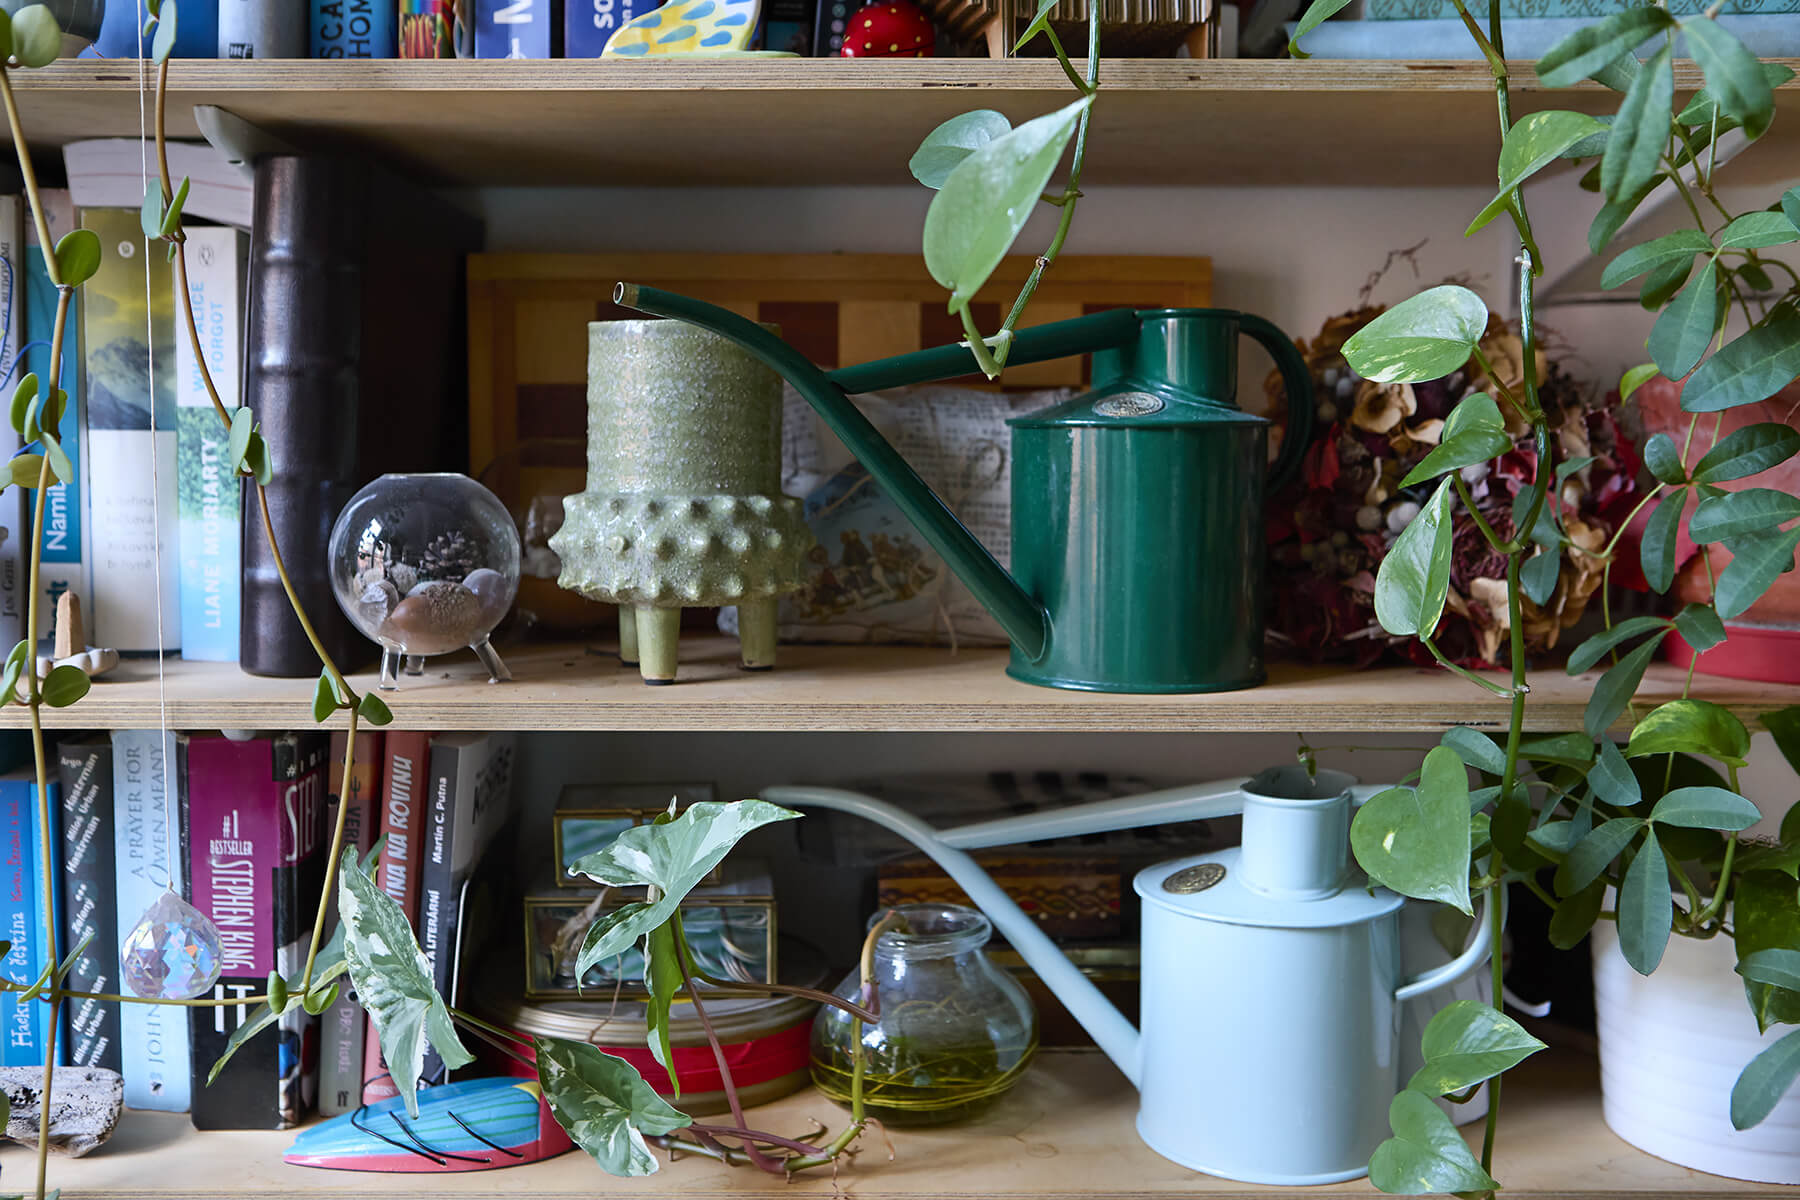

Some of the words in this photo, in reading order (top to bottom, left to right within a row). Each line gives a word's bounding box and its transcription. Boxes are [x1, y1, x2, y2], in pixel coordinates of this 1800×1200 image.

[191, 281, 205, 335] ALICE
[209, 301, 225, 374] FORGOT
[201, 437, 221, 555] MORIARTY
[205, 564, 221, 628] LIANE
[64, 752, 99, 812] Hastrman
[126, 745, 142, 784] FOR
[151, 743, 166, 813] MEANY
[388, 754, 413, 829] ROVINU
[78, 784, 100, 815] Urban
[433, 811, 446, 825] C.
[435, 776, 448, 810] Putna
[65, 815, 101, 874] Hastrman
[127, 791, 145, 860] PRAYER
[209, 840, 253, 857] BESTSELLER
[222, 809, 239, 839] #1
[387, 831, 408, 861] NA
[431, 828, 445, 865] Martin
[131, 868, 145, 880] A
[211, 859, 255, 930] STEPHEN
[8, 911, 28, 966] čeština
[425, 889, 441, 949] LITERÁRNÍ
[217, 931, 256, 970] KING
[85, 1008, 107, 1038] Urban
[146, 1004, 166, 1065] JOHN
[214, 983, 256, 1033] IT
